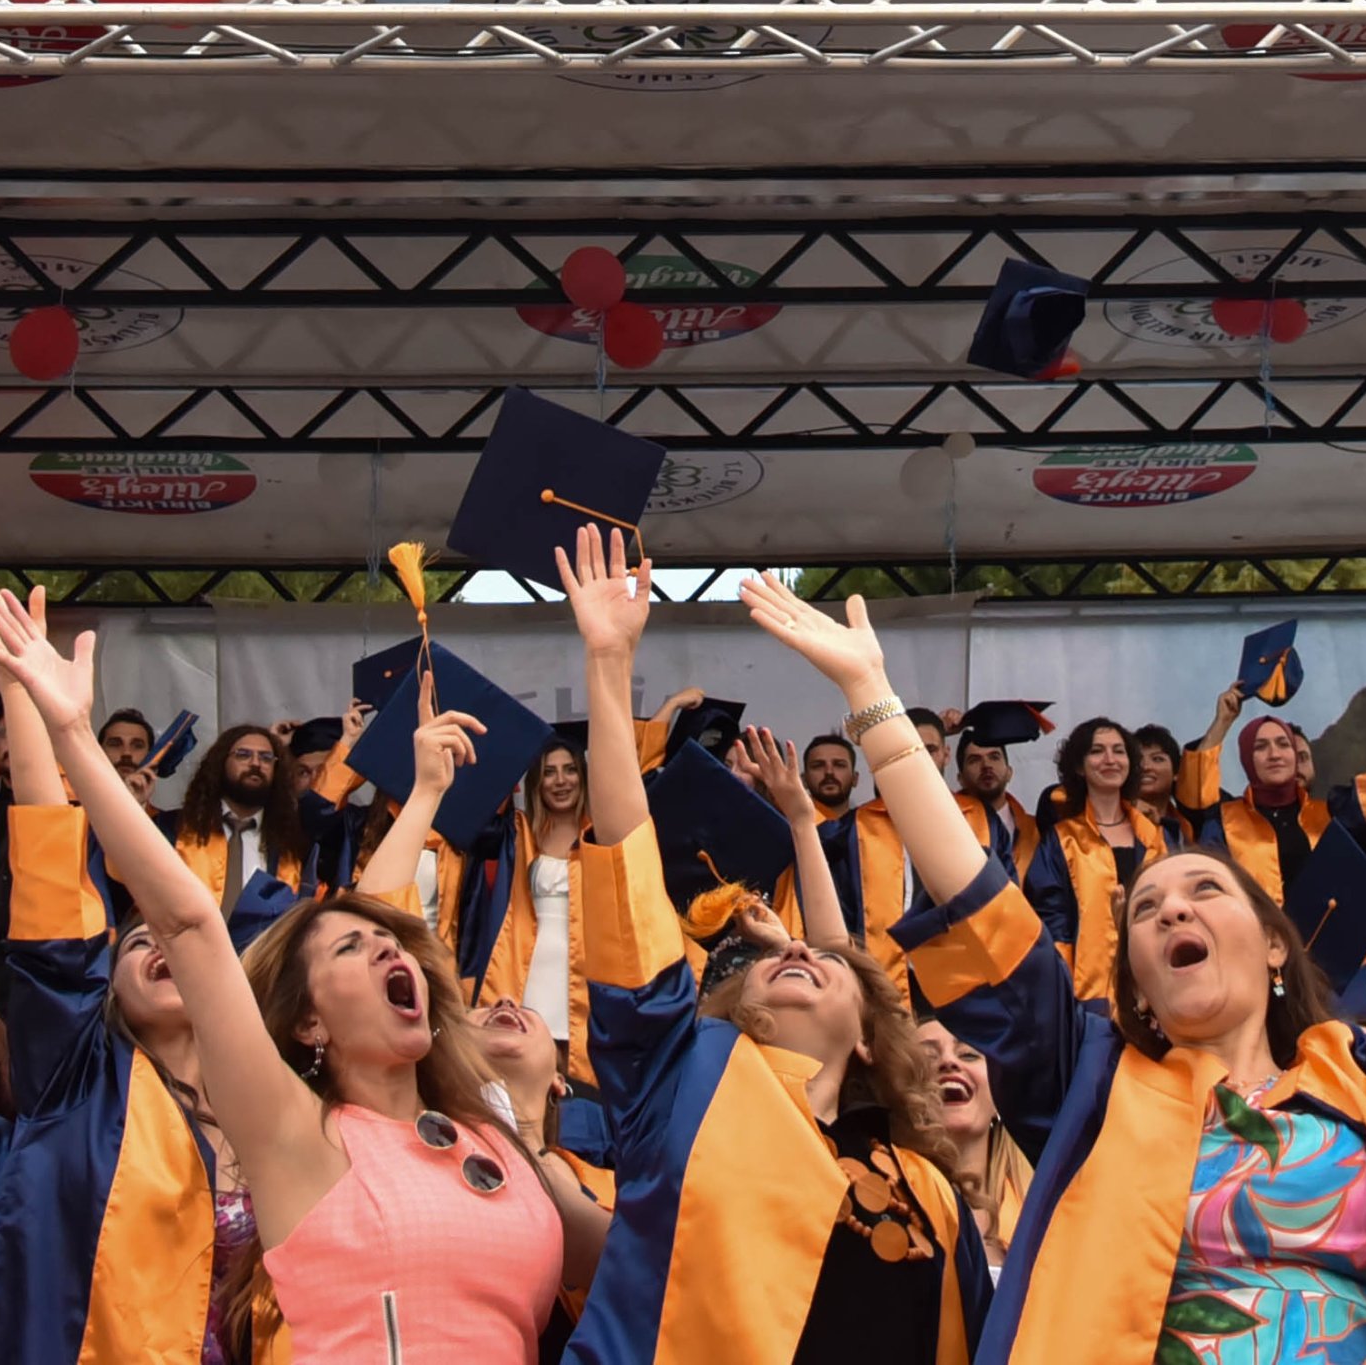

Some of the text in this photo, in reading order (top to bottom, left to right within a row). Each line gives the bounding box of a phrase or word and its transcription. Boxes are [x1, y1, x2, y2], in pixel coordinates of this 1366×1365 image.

[1092, 458, 1208, 468] BİRLİKTE
[80, 477, 227, 501] Aileyiz
[1071, 469, 1223, 494] Aileyiz
[1078, 492, 1190, 503] BİRLİKTE
